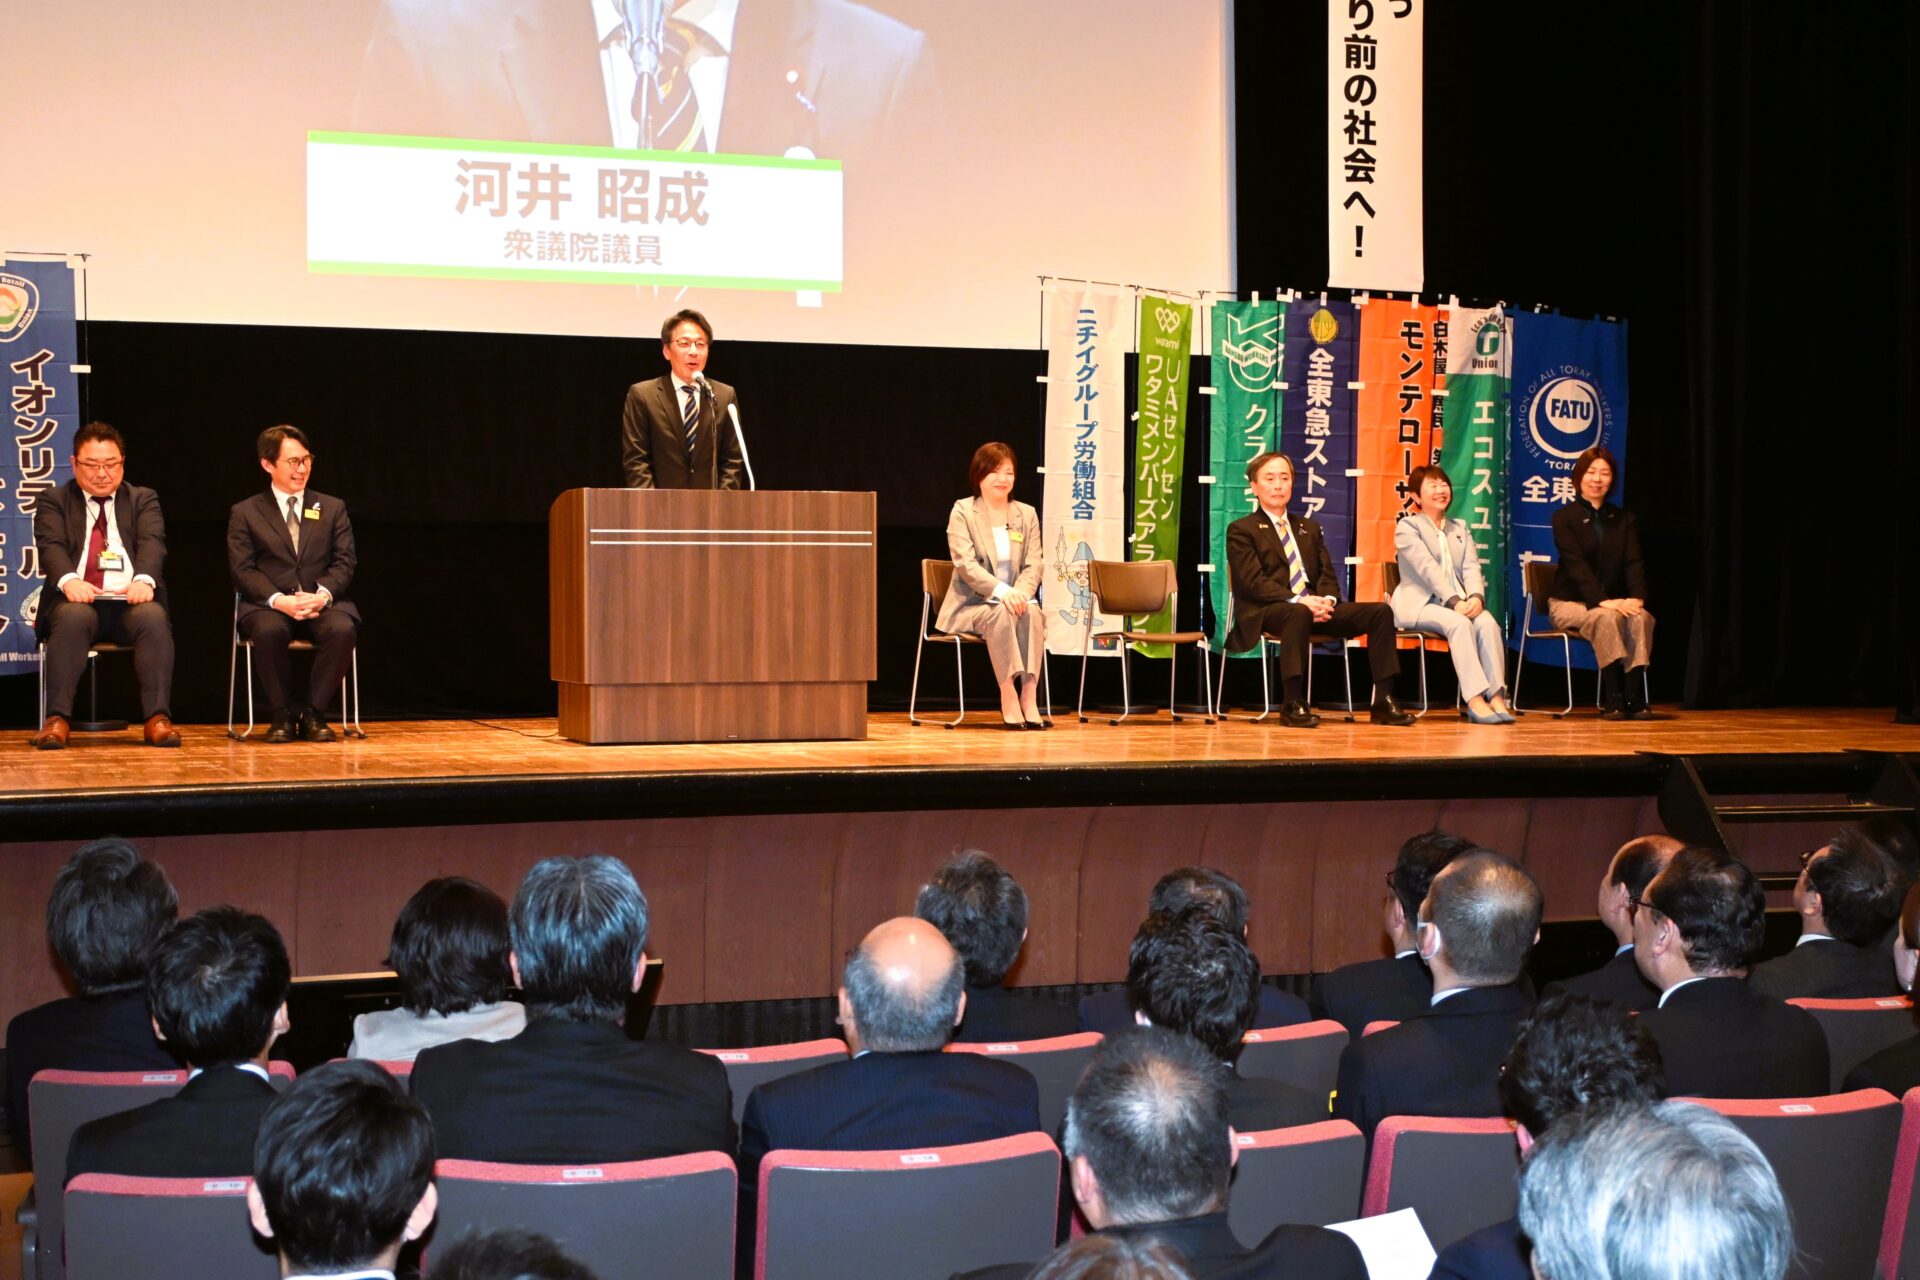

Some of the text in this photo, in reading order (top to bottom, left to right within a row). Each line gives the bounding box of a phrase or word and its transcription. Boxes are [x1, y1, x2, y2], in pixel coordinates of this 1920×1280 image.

[454, 158, 711, 227] 河井 昭成
[502, 228, 664, 267] 衆議院議員
[9, 346, 59, 579] イオンリテル
[1071, 308, 1099, 521] ニチイグループ労働組合
[1159, 358, 1182, 523] UAゼンセン
[1302, 347, 1336, 520] 全東急ストア
[1395, 320, 1425, 523] モンテロー
[1550, 397, 1591, 421] FATU
